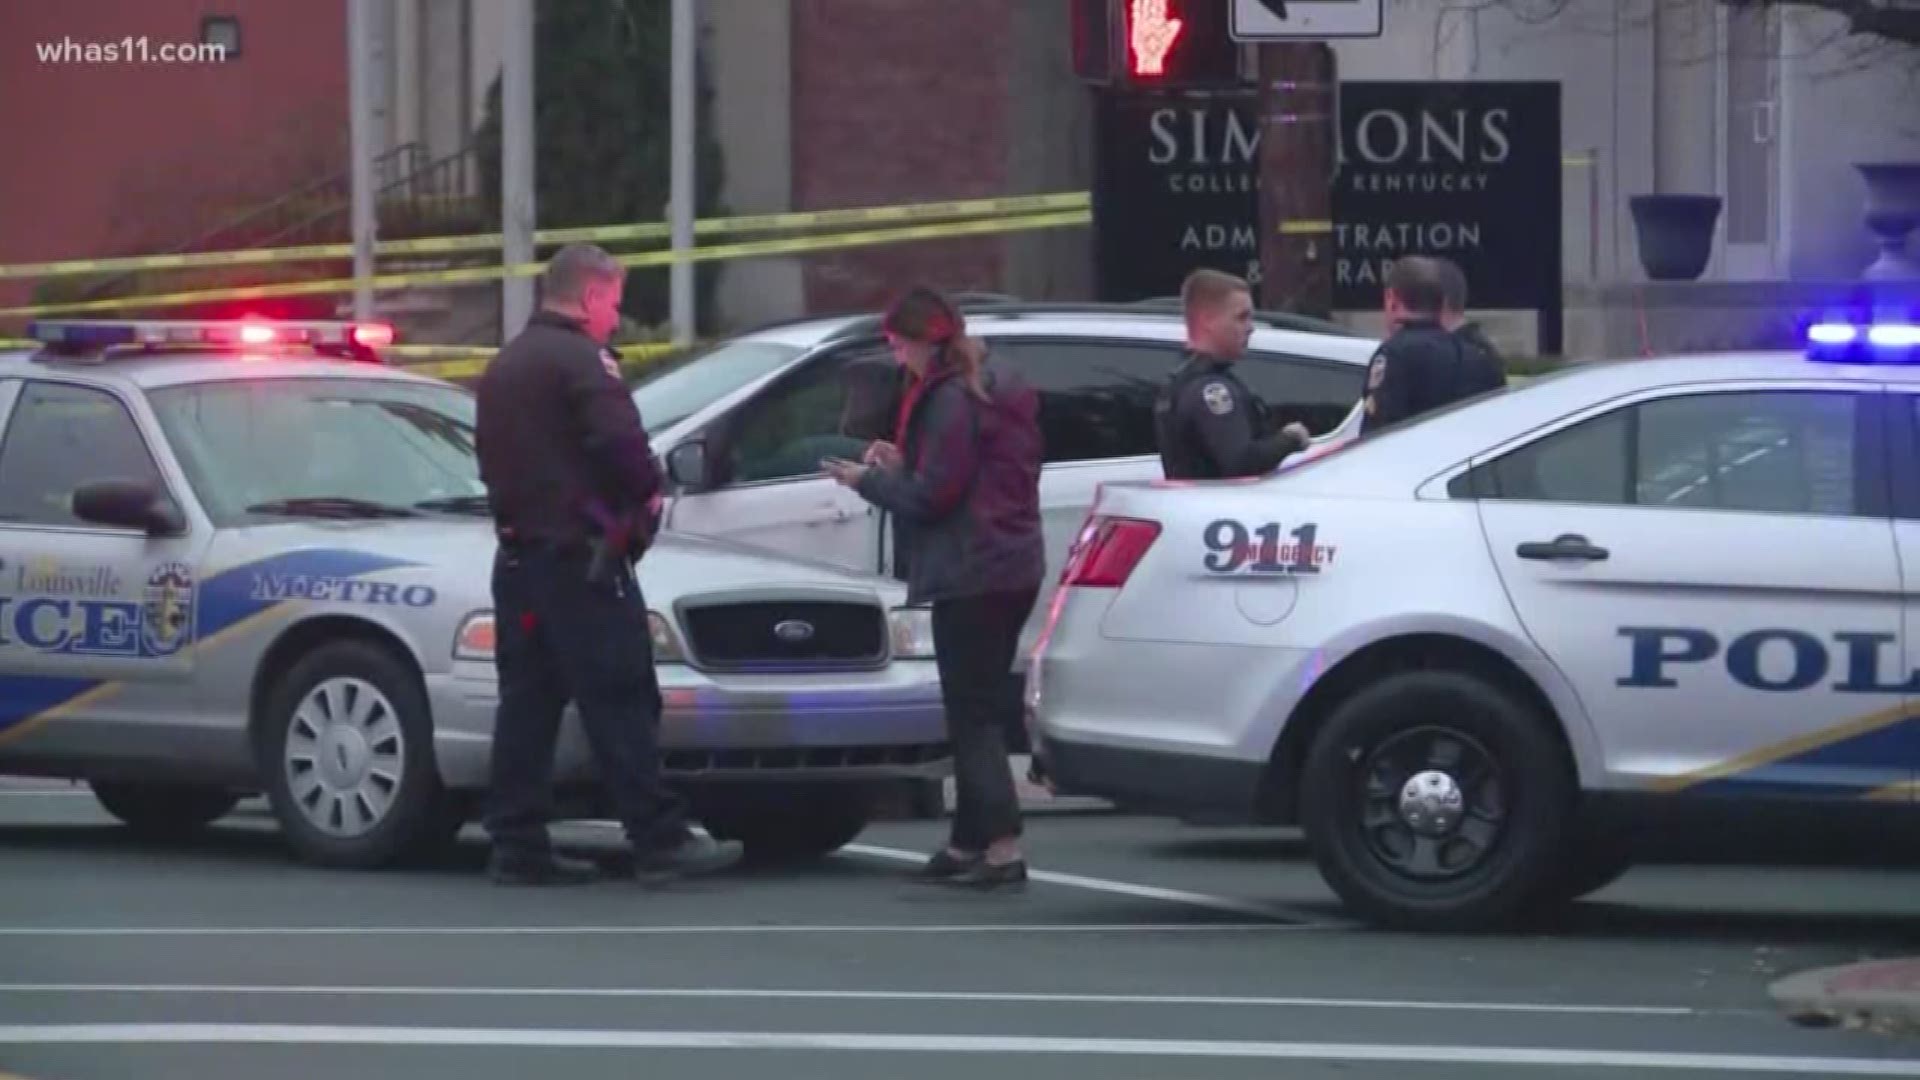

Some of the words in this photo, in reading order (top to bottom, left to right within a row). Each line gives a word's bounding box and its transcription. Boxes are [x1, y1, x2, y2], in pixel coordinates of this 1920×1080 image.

[1149, 108, 1511, 165] SIMONS
[1353, 173, 1489, 192] KENTUCKY
[1181, 223, 1481, 249] ADMTRATION
[1247, 259, 1262, 283] &
[1203, 518, 1321, 574] 911
[17, 565, 120, 595] Louisville
[250, 571, 437, 607] METRO
[1616, 626, 1920, 692] POL
